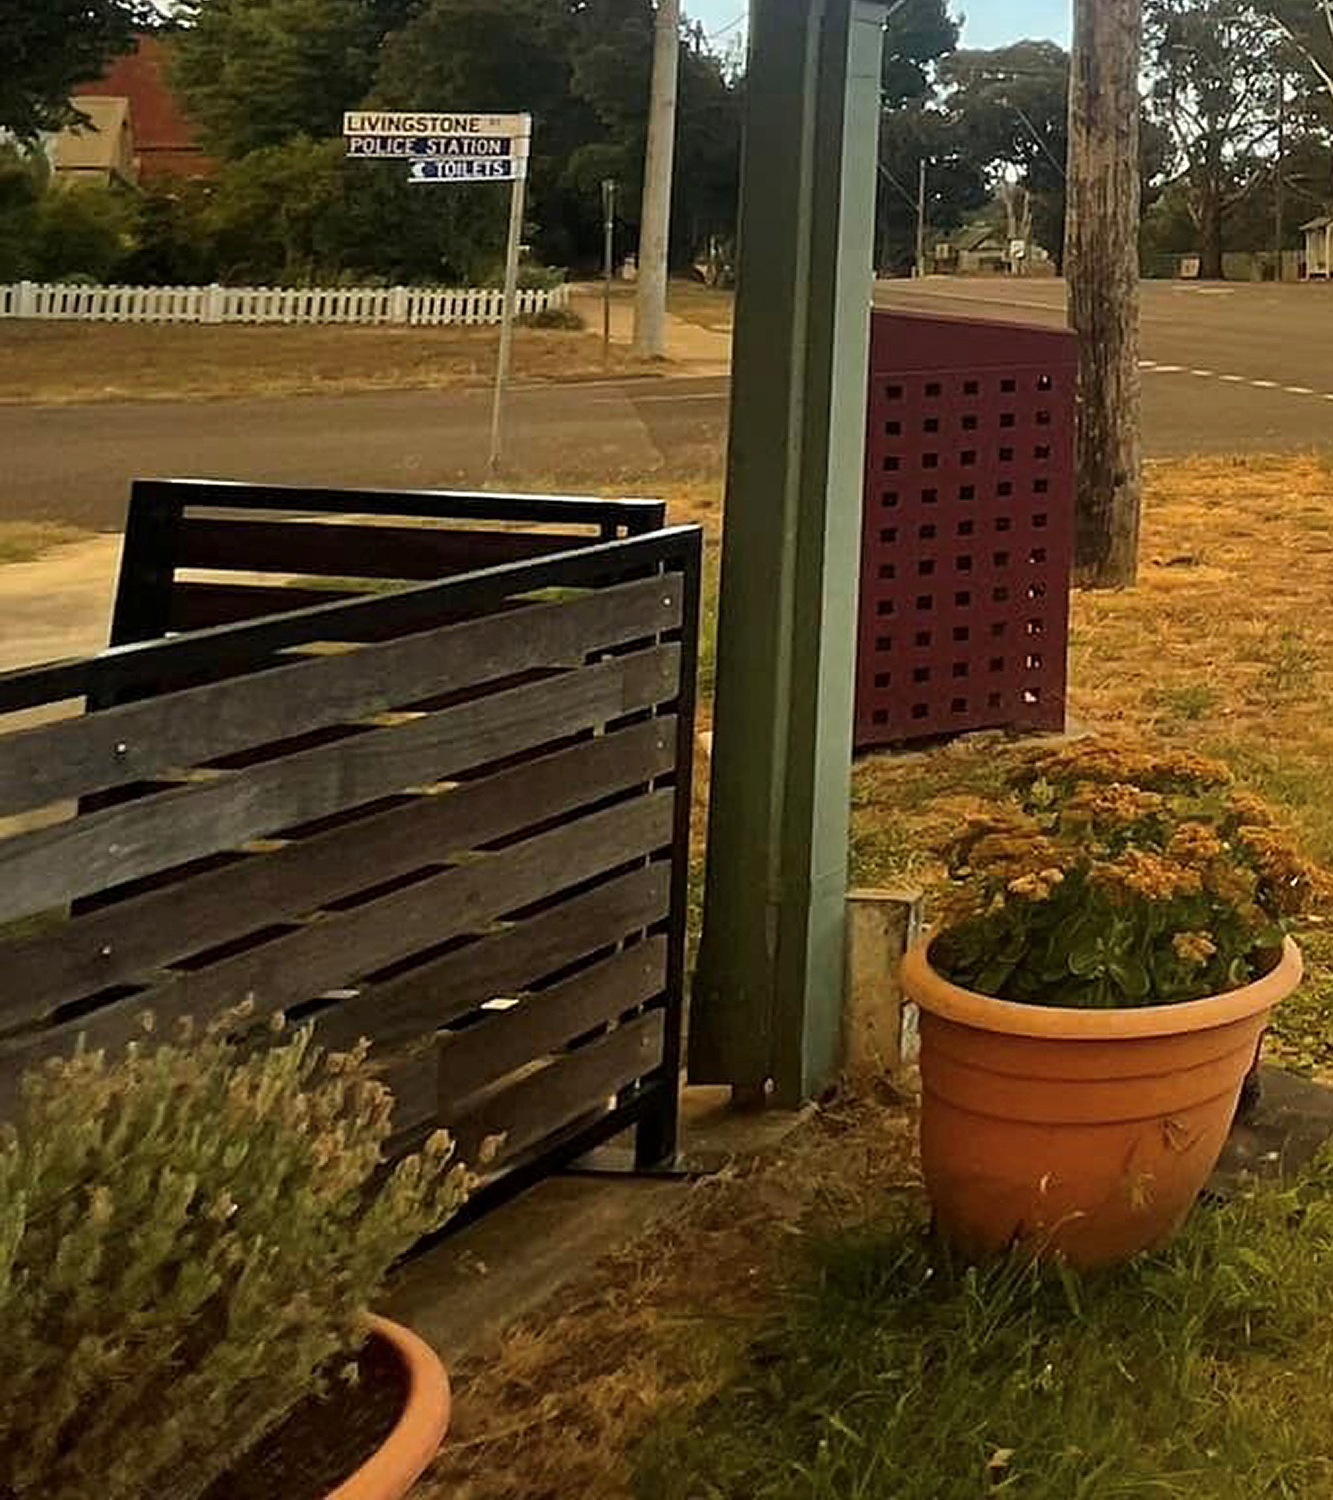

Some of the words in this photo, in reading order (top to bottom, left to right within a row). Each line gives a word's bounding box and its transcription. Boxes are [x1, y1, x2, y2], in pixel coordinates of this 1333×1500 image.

[346, 116, 480, 132] LIVINGSTONE
[350, 138, 416, 154] POLICE
[426, 139, 501, 154] STATION
[438, 161, 503, 176] TOILETS
